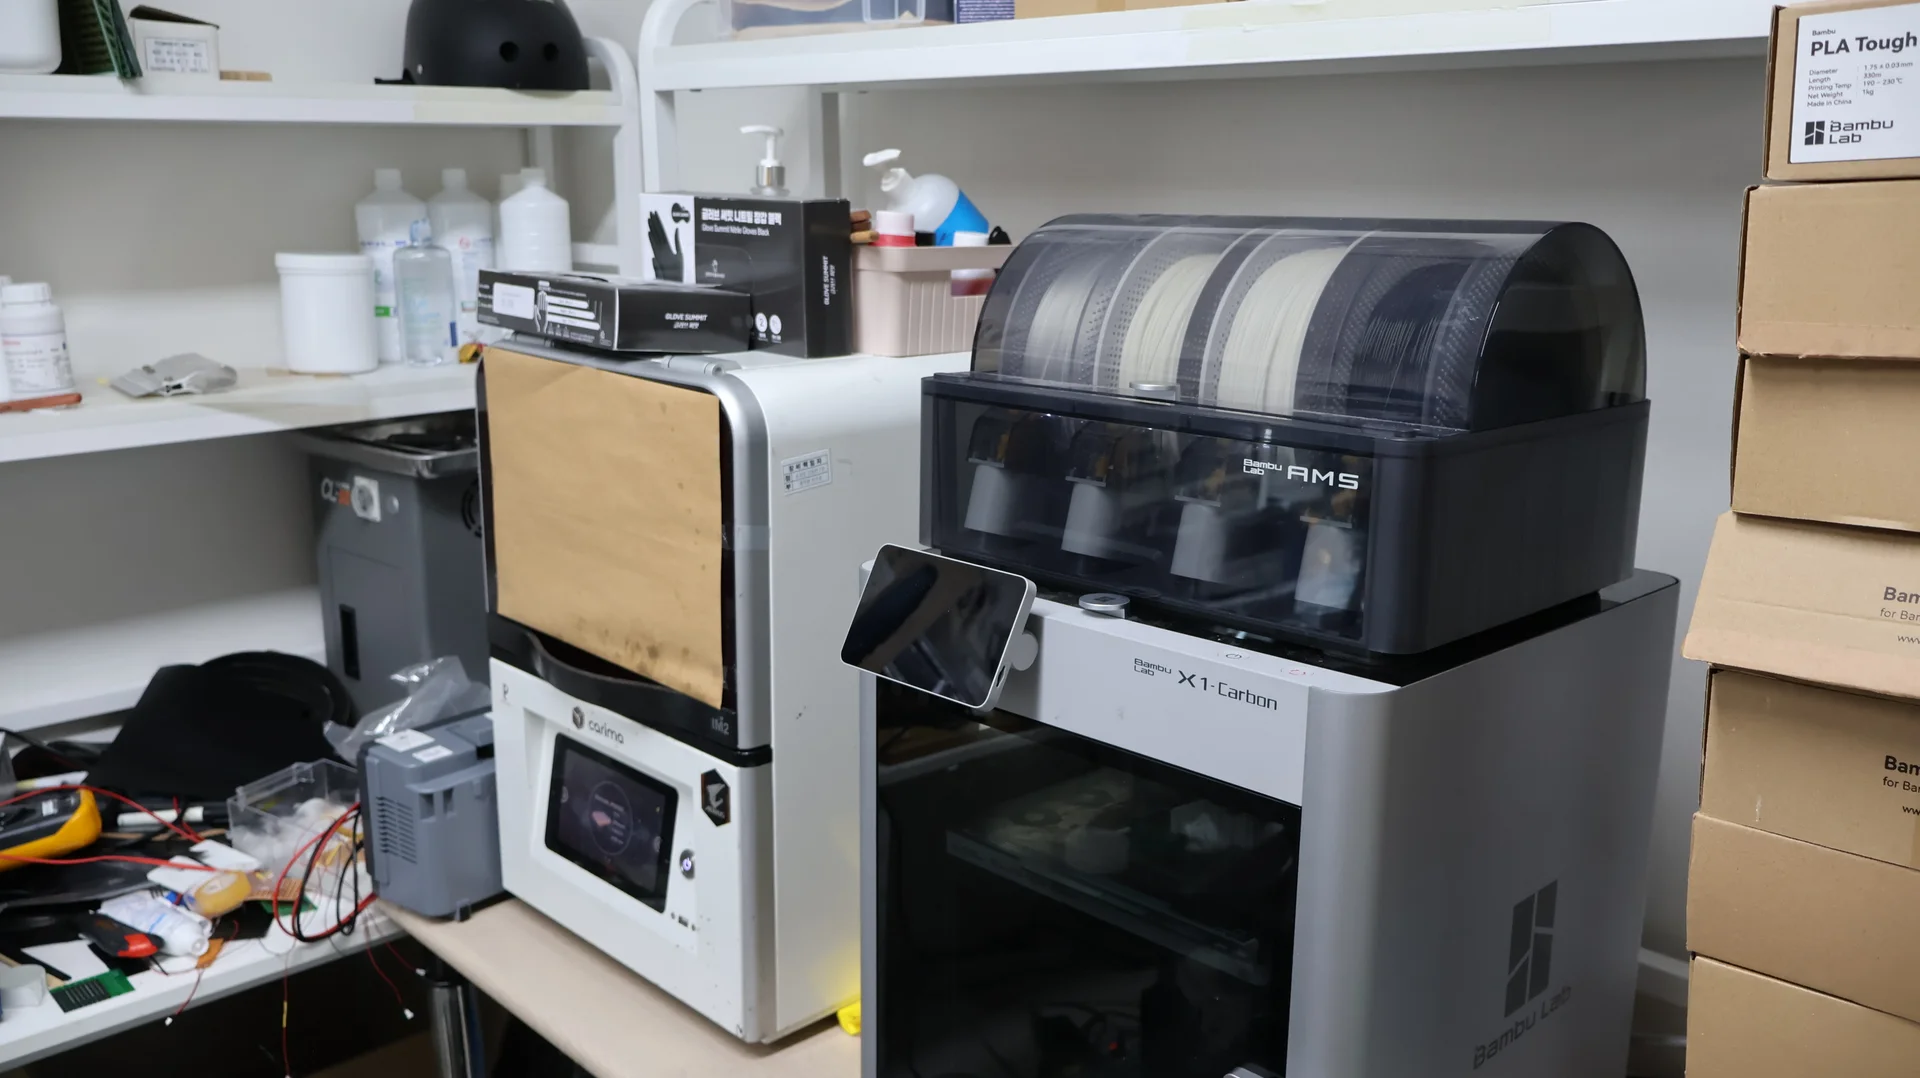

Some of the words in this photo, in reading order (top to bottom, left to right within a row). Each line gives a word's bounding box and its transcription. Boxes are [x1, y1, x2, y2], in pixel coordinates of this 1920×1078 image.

[1812, 28, 1836, 36] Bambu
[1811, 38, 1850, 56] PLA
[1855, 31, 1918, 53] Tough
[1809, 68, 1838, 76] Diameter
[1808, 83, 1834, 91] Printing
[1863, 79, 1876, 87] 190
[1809, 76, 1831, 84] Length
[1820, 91, 1844, 99] Weight
[1830, 120, 1894, 132] Bambu
[1829, 133, 1862, 144] Lab
[664, 313, 684, 321] GLOVE
[684, 313, 708, 322] SUMMIT
[1242, 465, 1265, 476] Lab
[1243, 458, 1283, 471] Bambu
[1287, 465, 1360, 490] AMS
[1880, 607, 1897, 618] for
[1133, 658, 1172, 675] Bambu
[1133, 665, 1155, 677] Lab
[588, 719, 625, 745] carima
[1882, 776, 1899, 788] for
[1902, 780, 1920, 793] Ba
[1473, 1010, 1537, 1070] Bambu
[1541, 985, 1572, 1020] Lab
